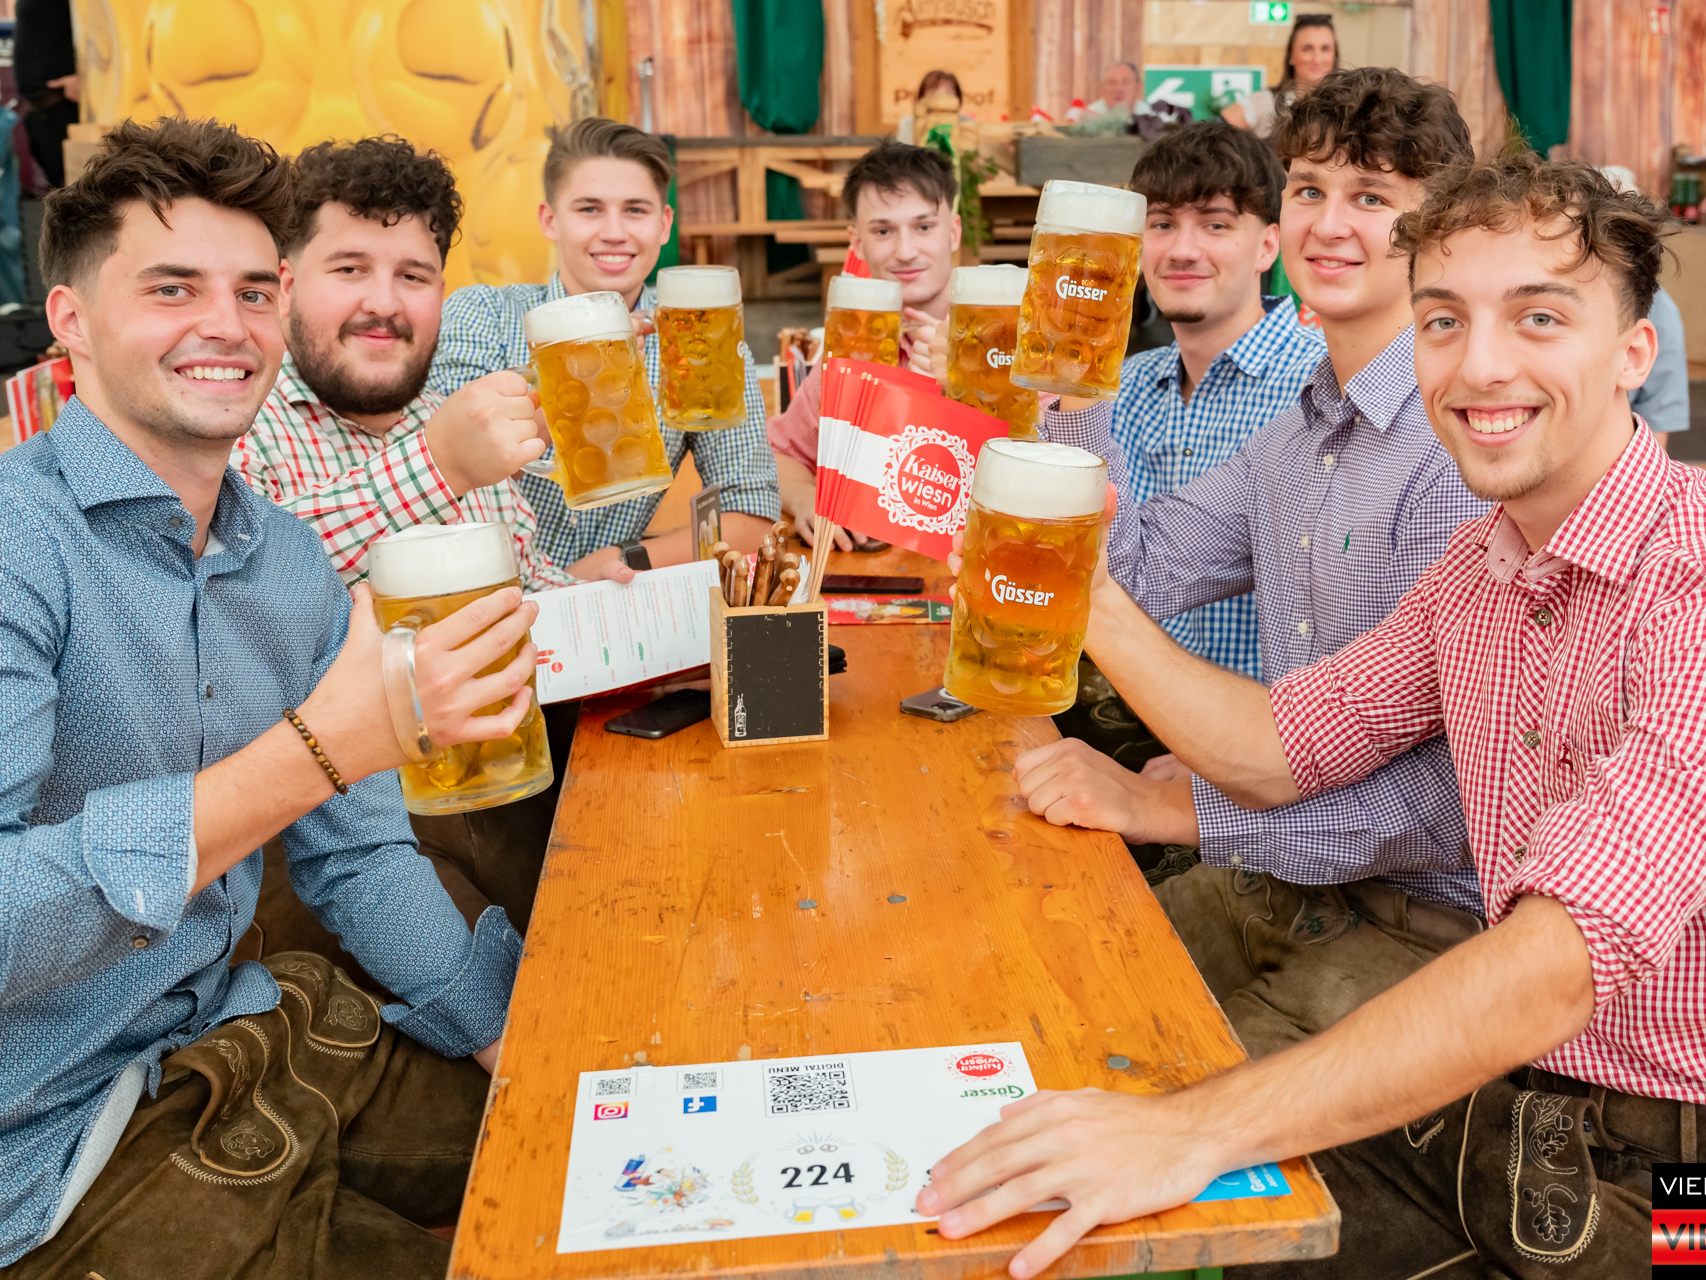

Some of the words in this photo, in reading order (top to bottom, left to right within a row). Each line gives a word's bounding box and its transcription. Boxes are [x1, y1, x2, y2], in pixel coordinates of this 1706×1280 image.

[1055, 275, 1108, 301] Gösser
[902, 454, 961, 491] Kaiser
[902, 476, 953, 508] wiesn
[913, 496, 921, 505] in
[921, 499, 938, 511] Wien
[991, 574, 1055, 606] Gösser
[768, 1066, 800, 1075] MENU
[804, 1062, 844, 1072] DIGITAL
[960, 1084, 1025, 1099] Gösser
[780, 1162, 855, 1189] 224
